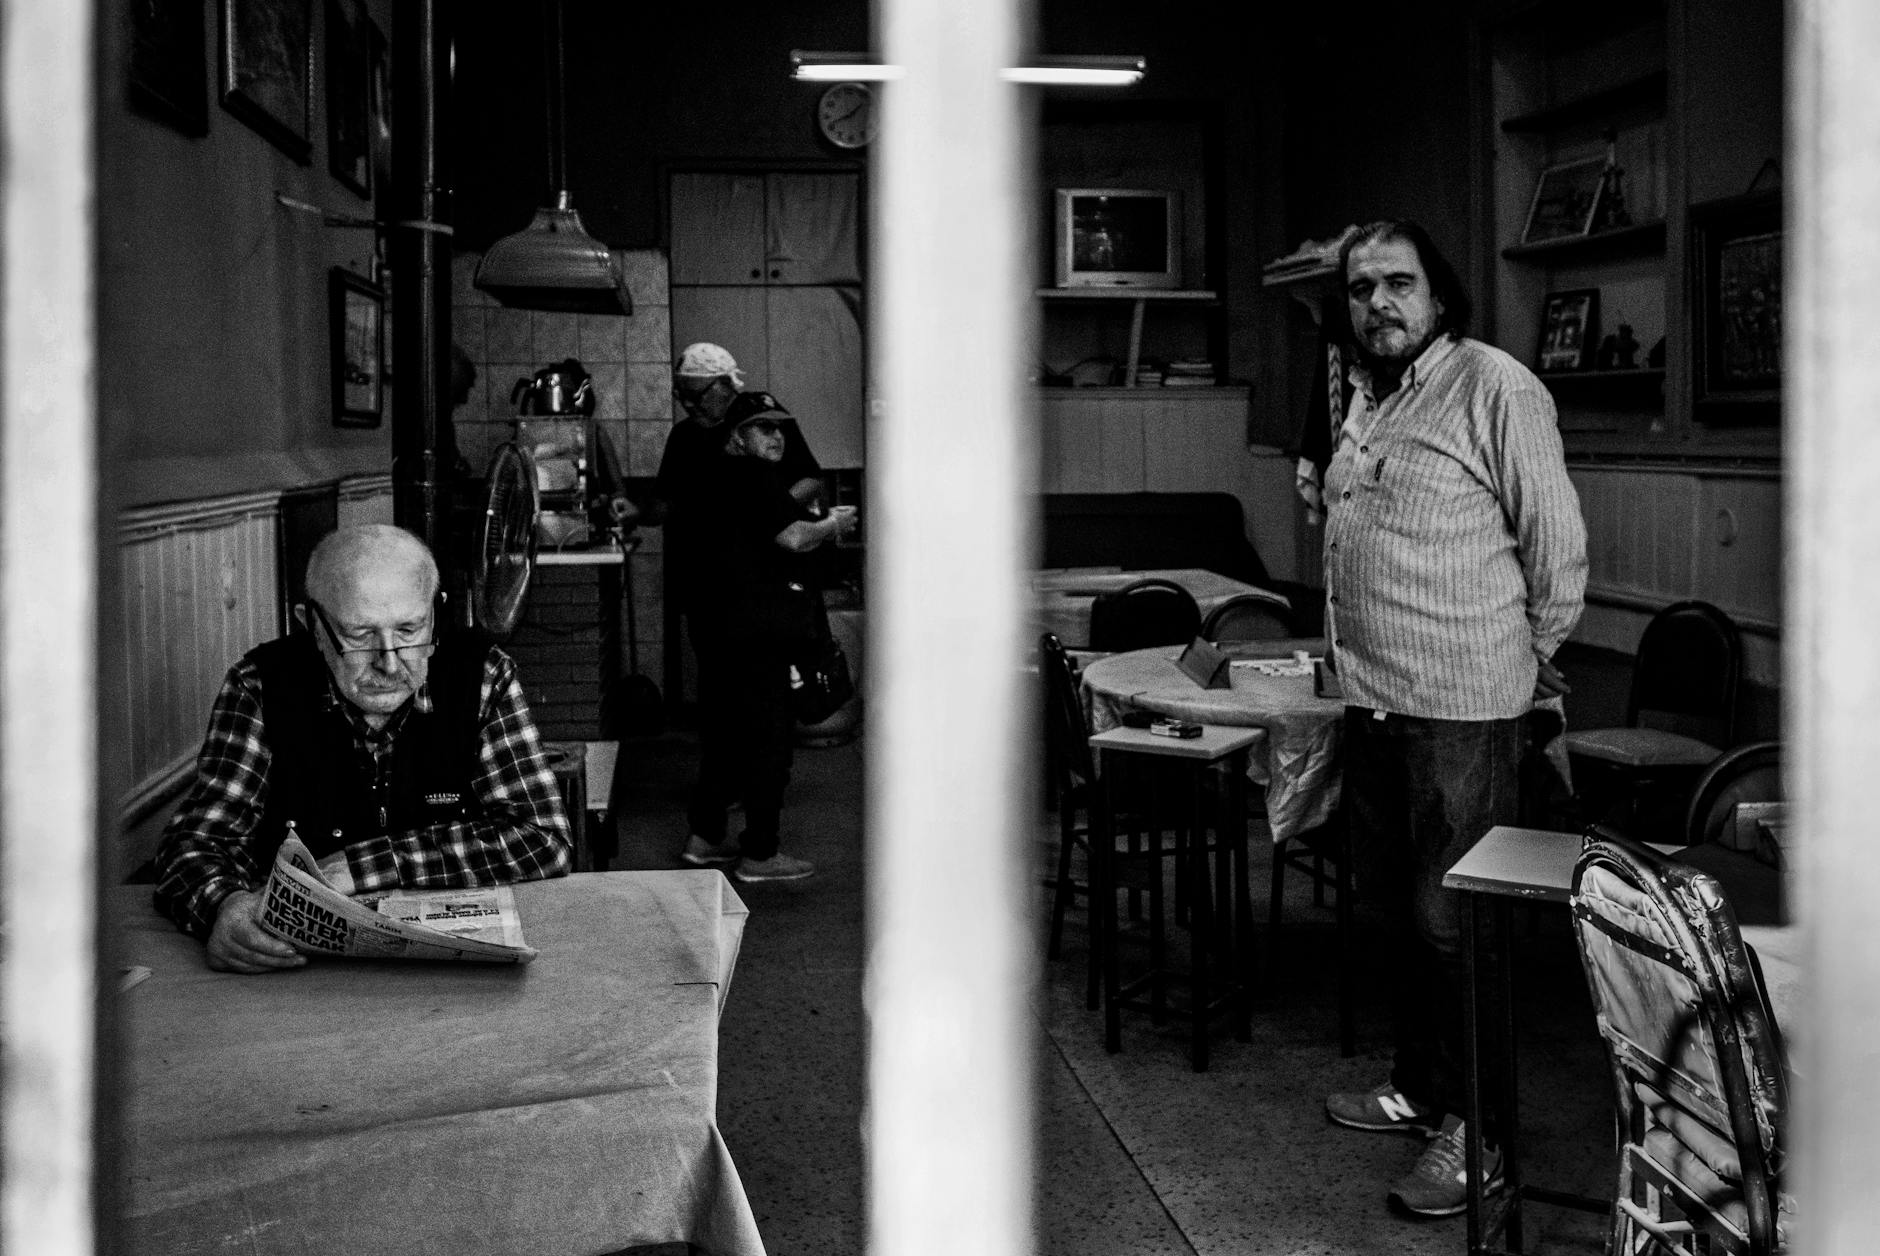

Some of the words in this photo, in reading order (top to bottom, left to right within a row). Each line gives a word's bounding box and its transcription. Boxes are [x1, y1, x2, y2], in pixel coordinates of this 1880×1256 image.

[268, 894, 347, 944] DESTEK
[272, 877, 348, 932] TARIMA
[264, 911, 344, 952] ARTACAK
[1377, 1094, 1417, 1121] N
